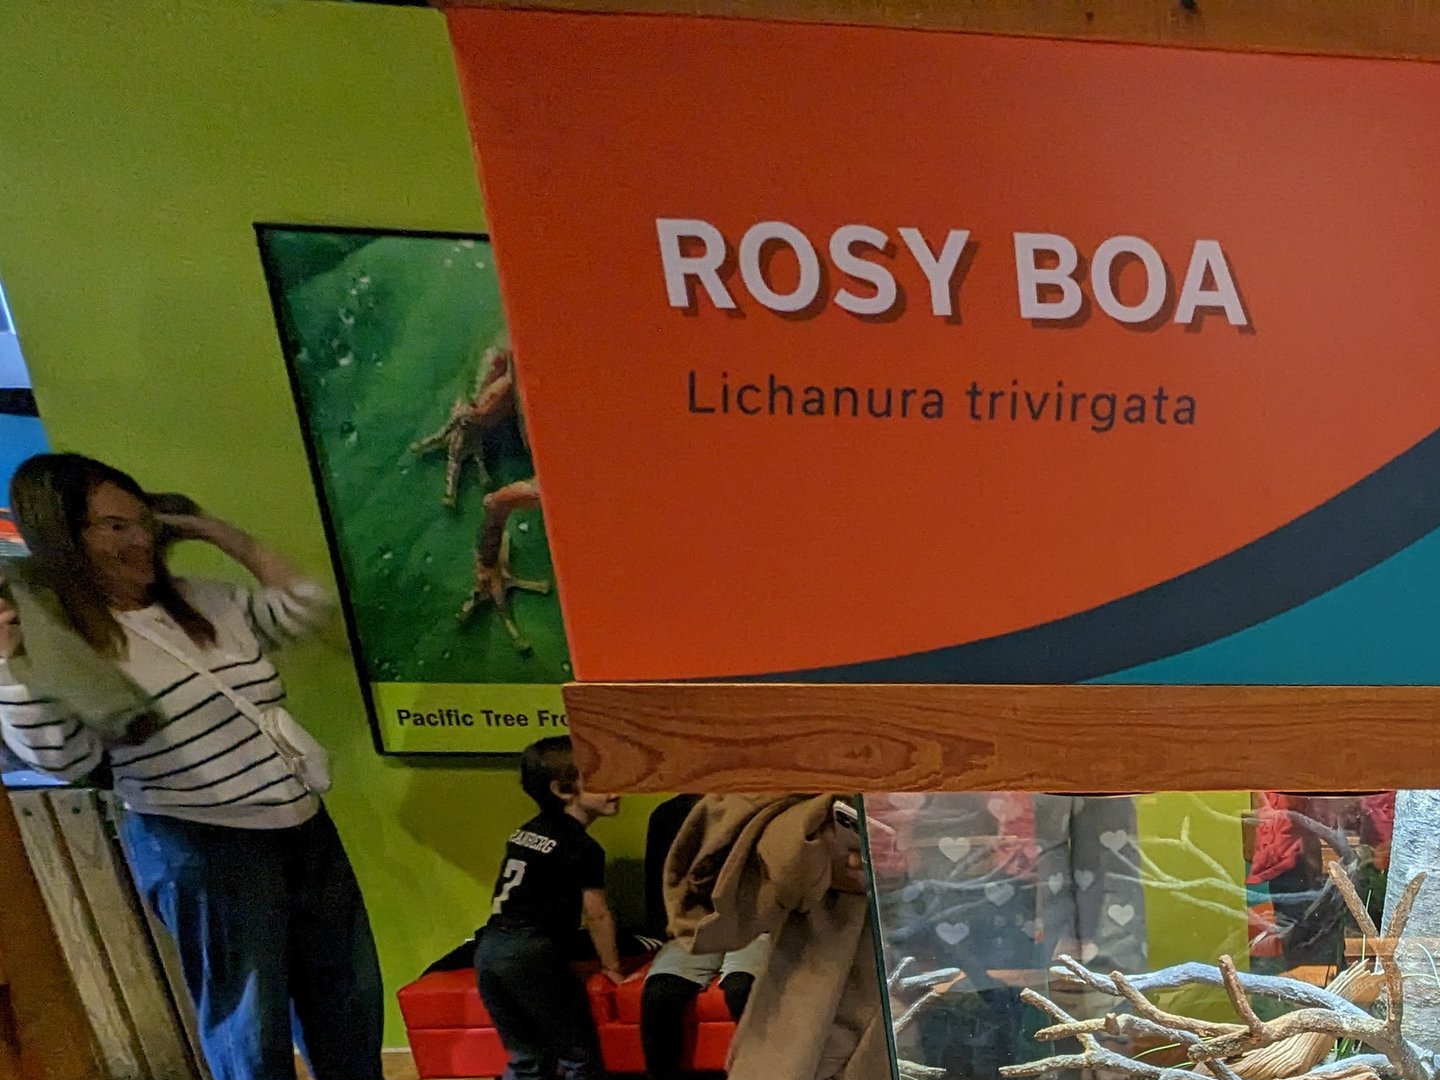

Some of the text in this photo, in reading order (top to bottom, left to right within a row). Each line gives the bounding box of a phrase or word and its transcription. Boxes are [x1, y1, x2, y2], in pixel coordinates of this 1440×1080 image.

[655, 217, 1249, 327] ROSY BOA
[687, 370, 1197, 433] Lichanura trivirgata
[397, 709, 475, 727] Pacific
[481, 710, 529, 727] Tree
